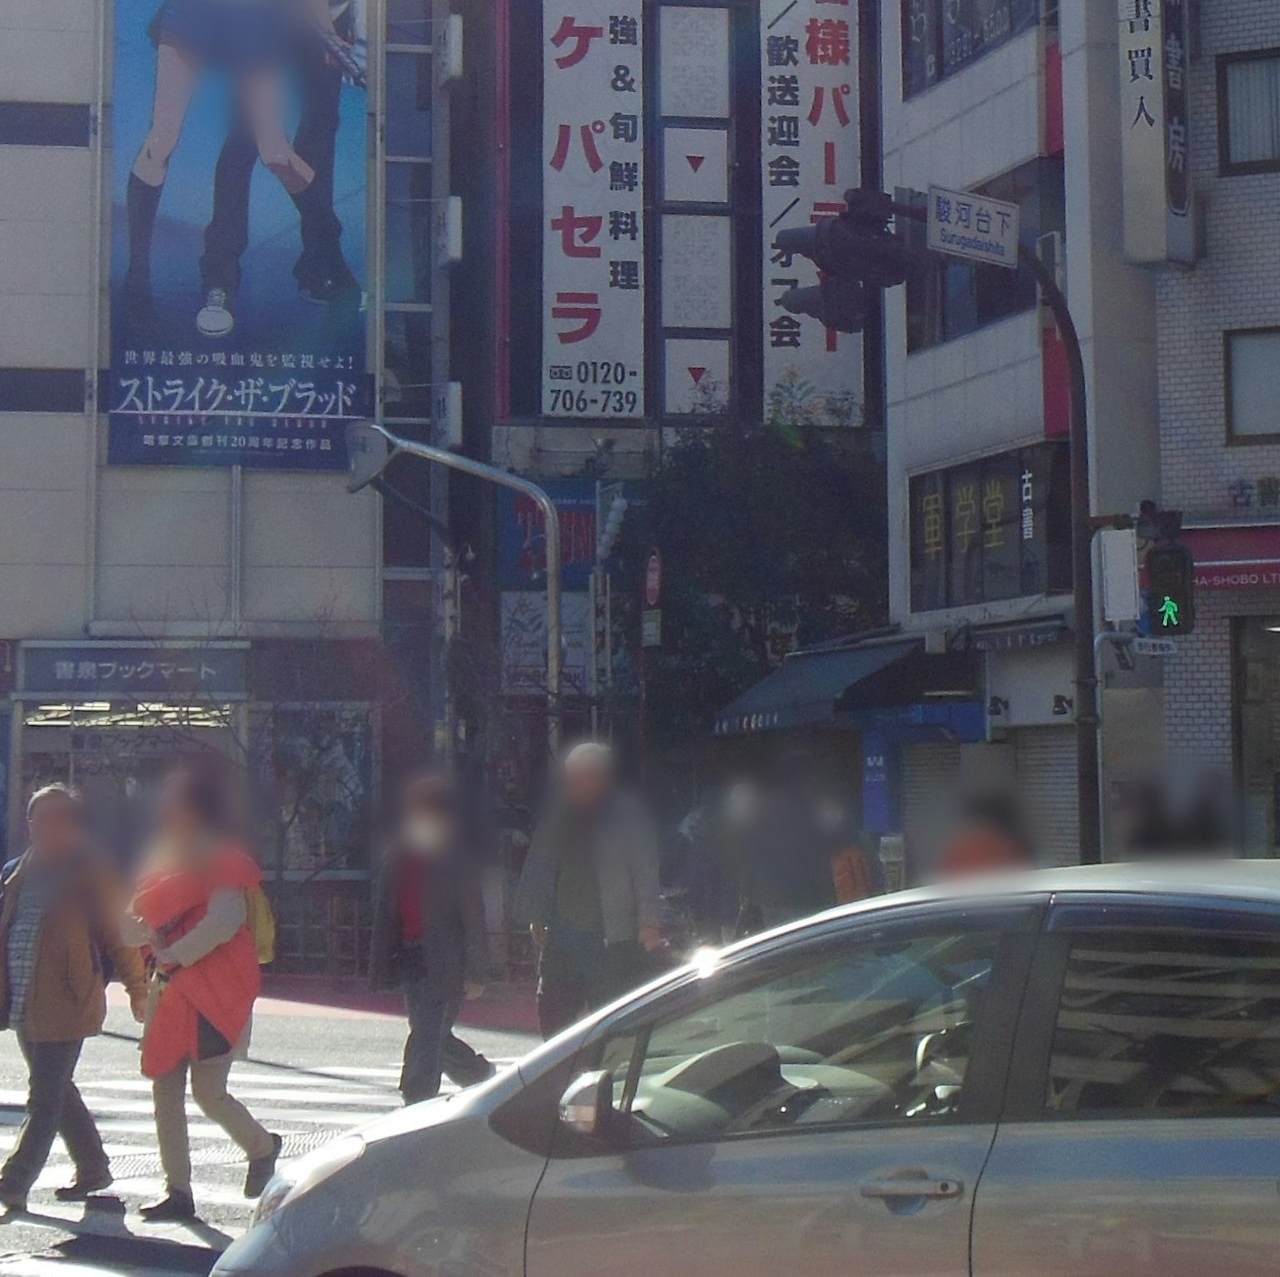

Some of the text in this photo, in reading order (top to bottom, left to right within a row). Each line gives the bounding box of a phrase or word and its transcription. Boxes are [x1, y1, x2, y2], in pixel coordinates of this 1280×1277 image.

[937, 196, 1011, 237] 駿河台下
[577, 361, 638, 384] 0120-
[119, 375, 357, 419] ストライク・ザ・ブラッド
[549, 388, 637, 413] 706-739
[1022, 469, 1034, 541] 古書
[55, 660, 217, 681] 書泉ブックマート
